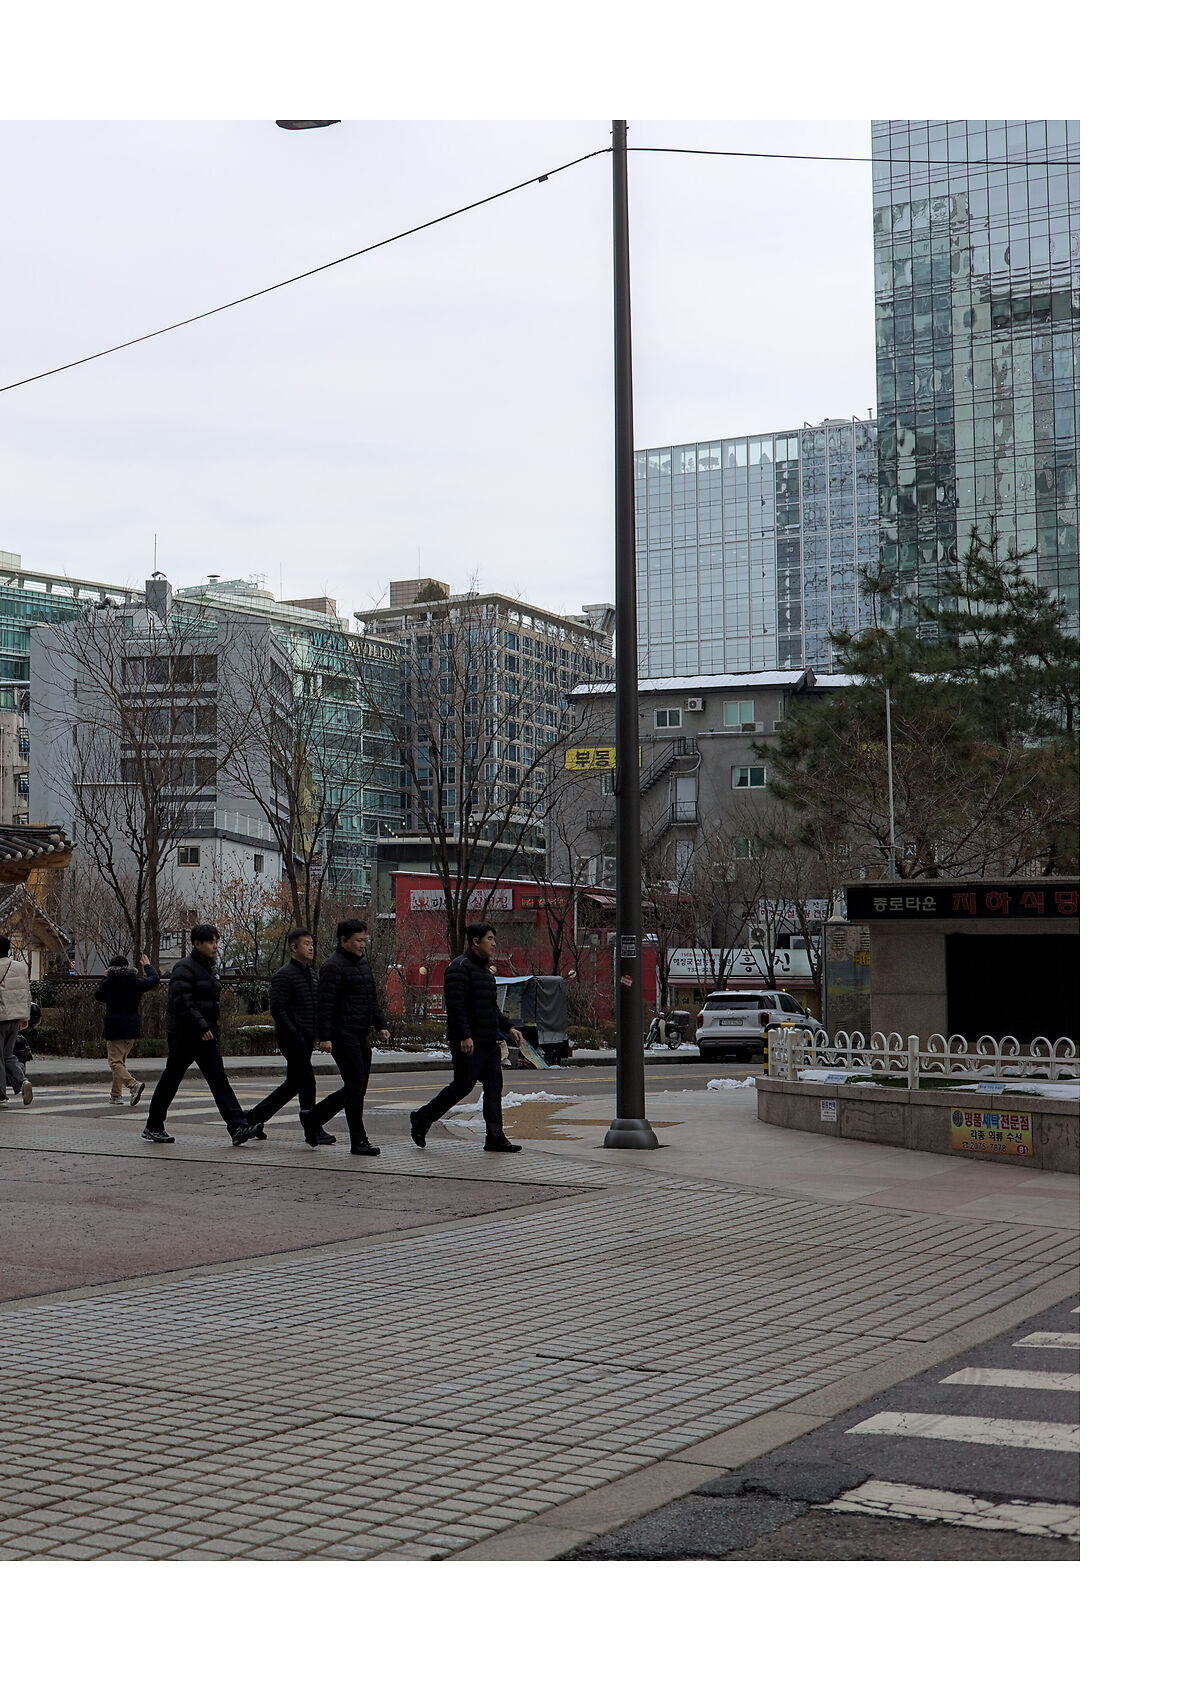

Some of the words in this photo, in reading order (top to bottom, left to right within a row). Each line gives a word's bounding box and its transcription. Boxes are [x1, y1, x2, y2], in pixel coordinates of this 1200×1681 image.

[346, 640, 398, 661] PAVILION
[575, 749, 613, 768] 부동
[873, 896, 937, 912] 종로타운
[951, 890, 1080, 915] 지하식당
[970, 1129, 985, 1141] 각종
[988, 1131, 1003, 1142] 의류
[1006, 1132, 1023, 1143] 수선
